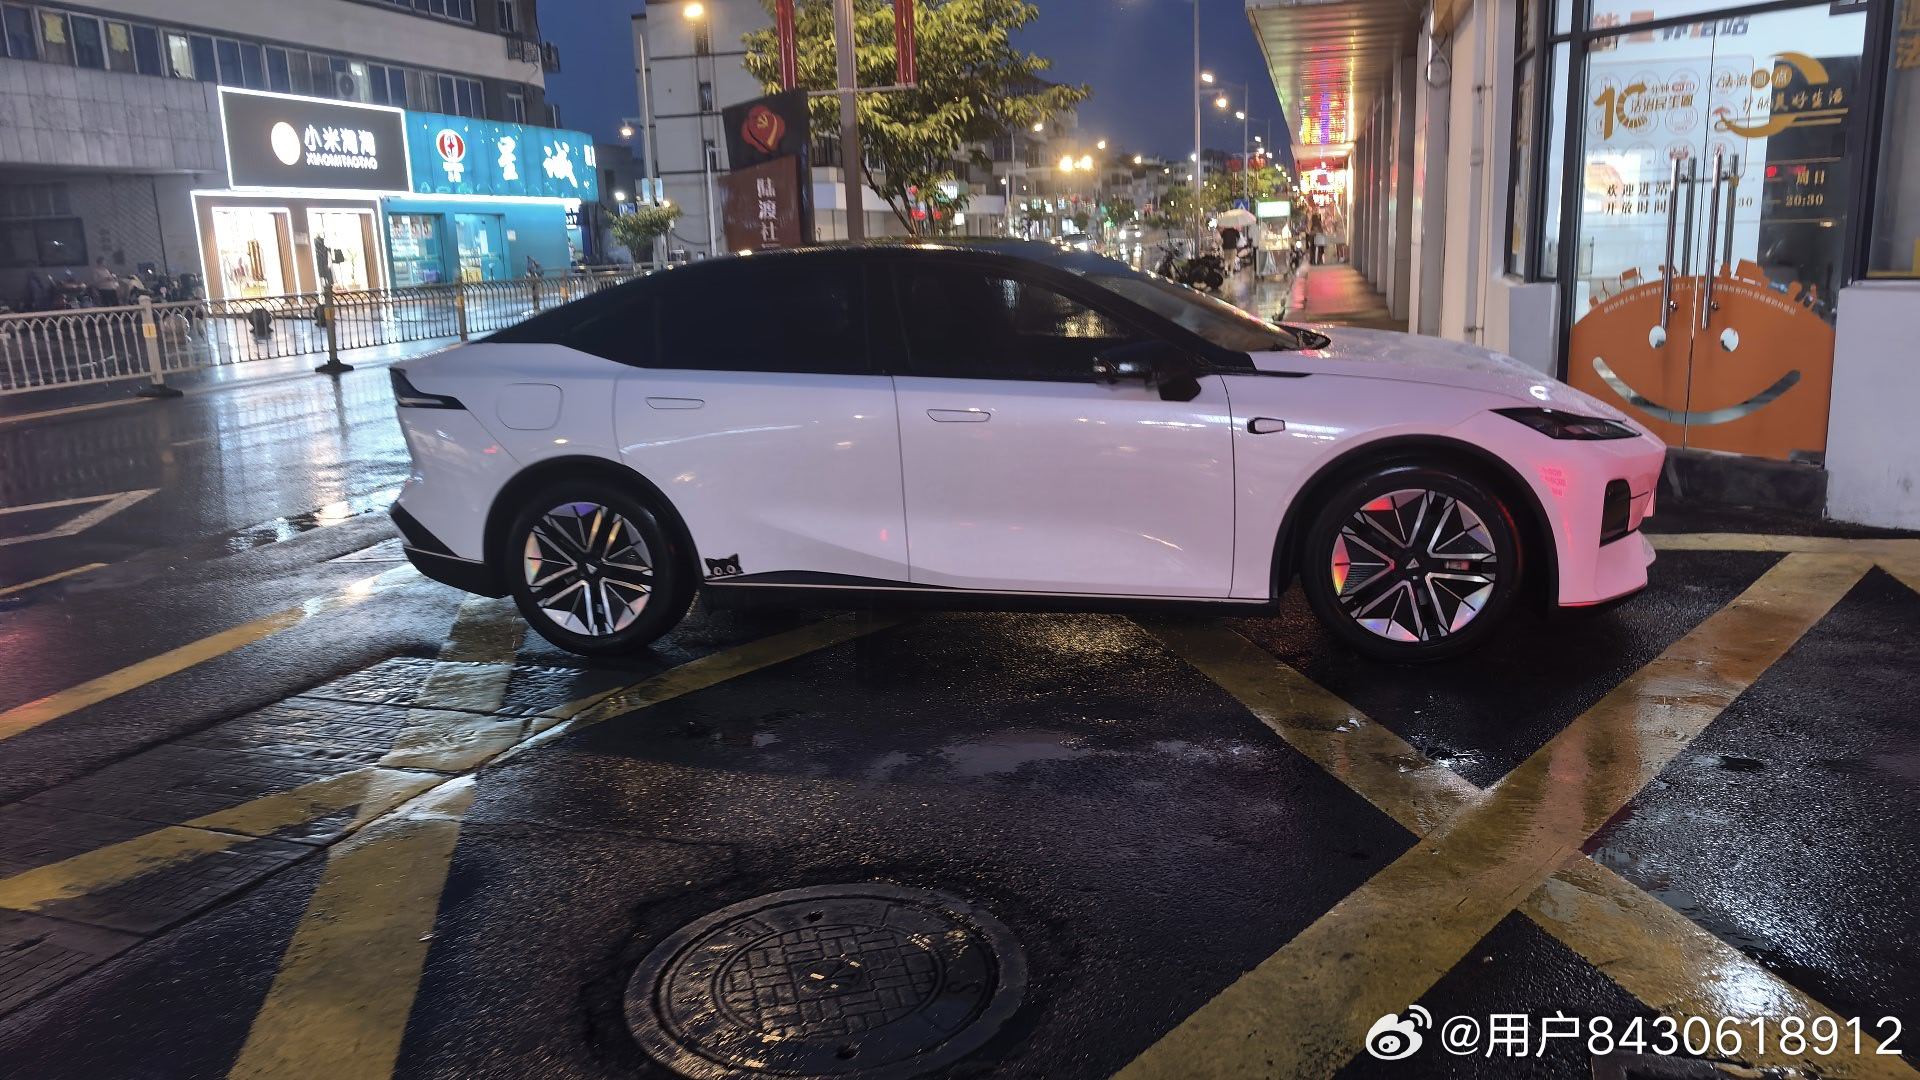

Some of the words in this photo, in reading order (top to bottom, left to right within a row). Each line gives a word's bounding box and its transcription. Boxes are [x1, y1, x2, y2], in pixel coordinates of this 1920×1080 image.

[1606, 181, 1667, 197] 欢迎进站
[757, 177, 780, 248] 陆渡社
